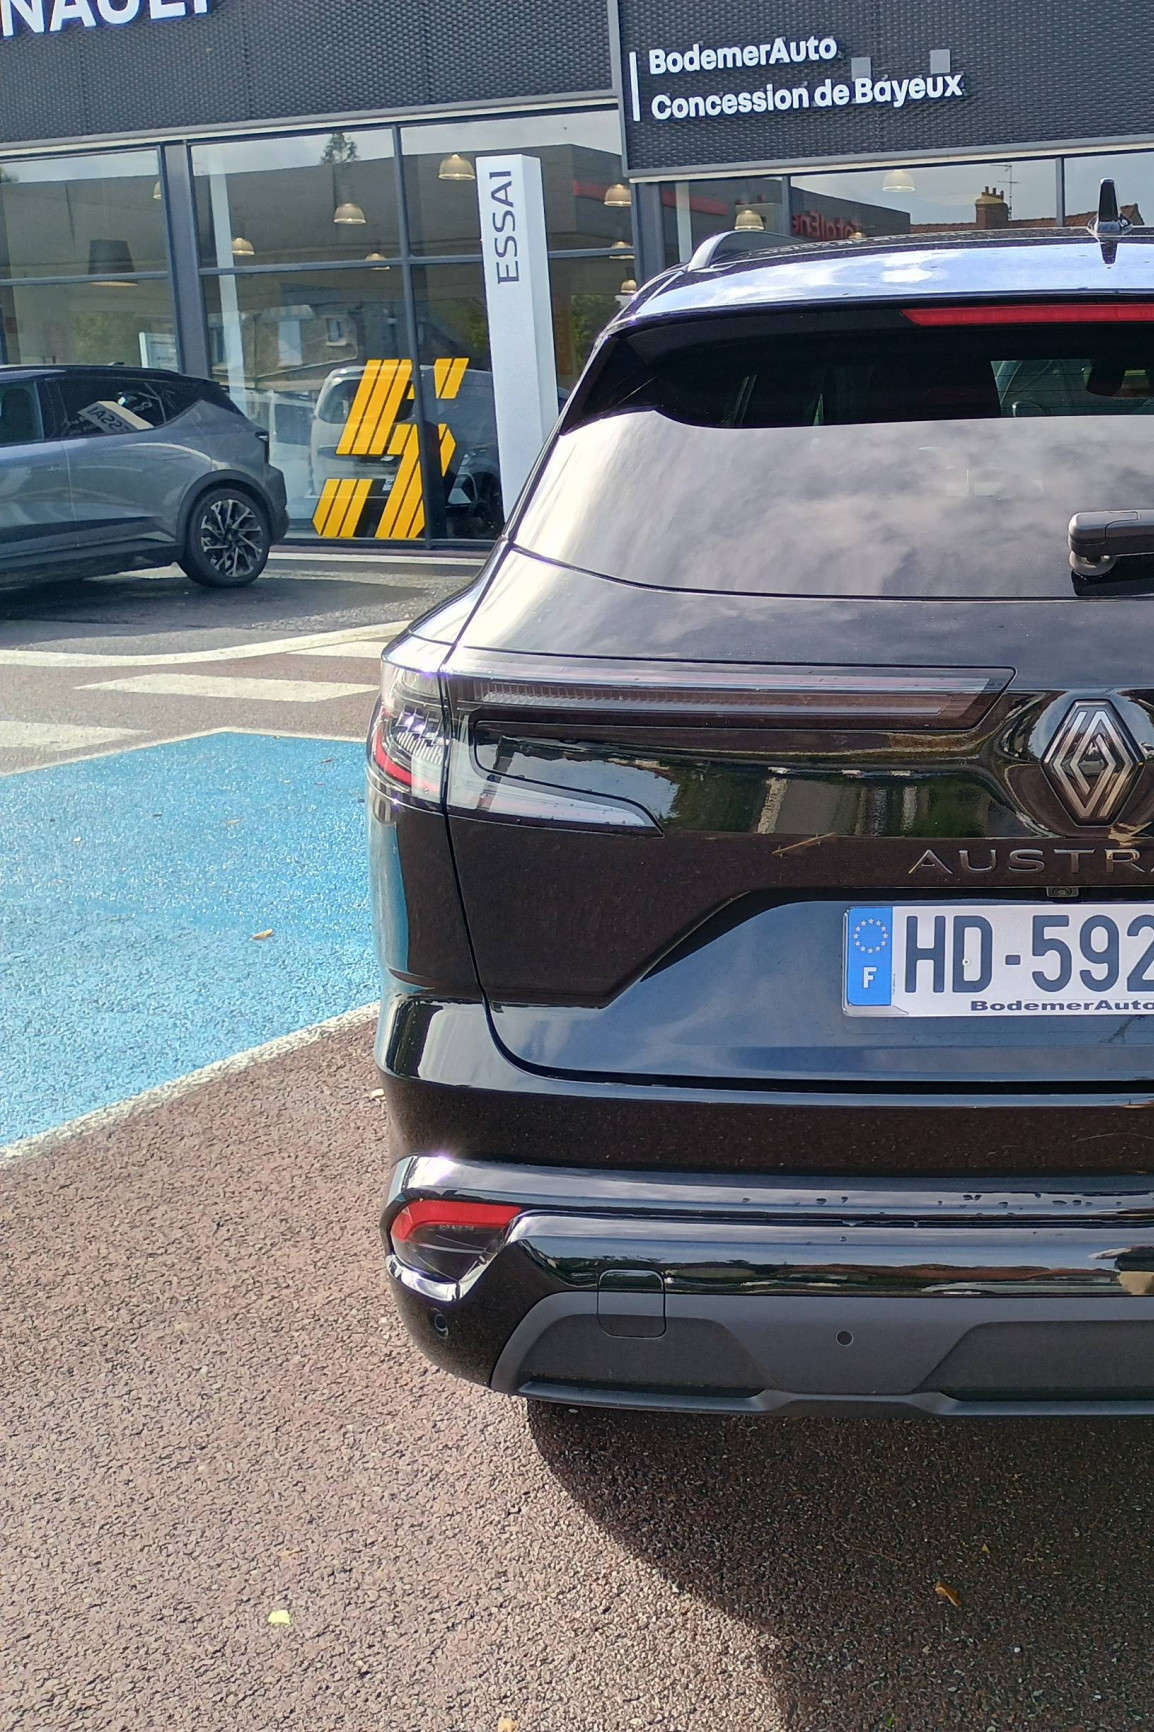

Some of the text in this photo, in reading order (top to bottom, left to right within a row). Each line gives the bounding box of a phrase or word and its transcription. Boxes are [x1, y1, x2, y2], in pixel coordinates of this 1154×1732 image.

[649, 36, 838, 75] BodemerAuto
[651, 74, 963, 120] Concession de Bayeux
[489, 170, 520, 285] ESSAI
[863, 966, 878, 989] F
